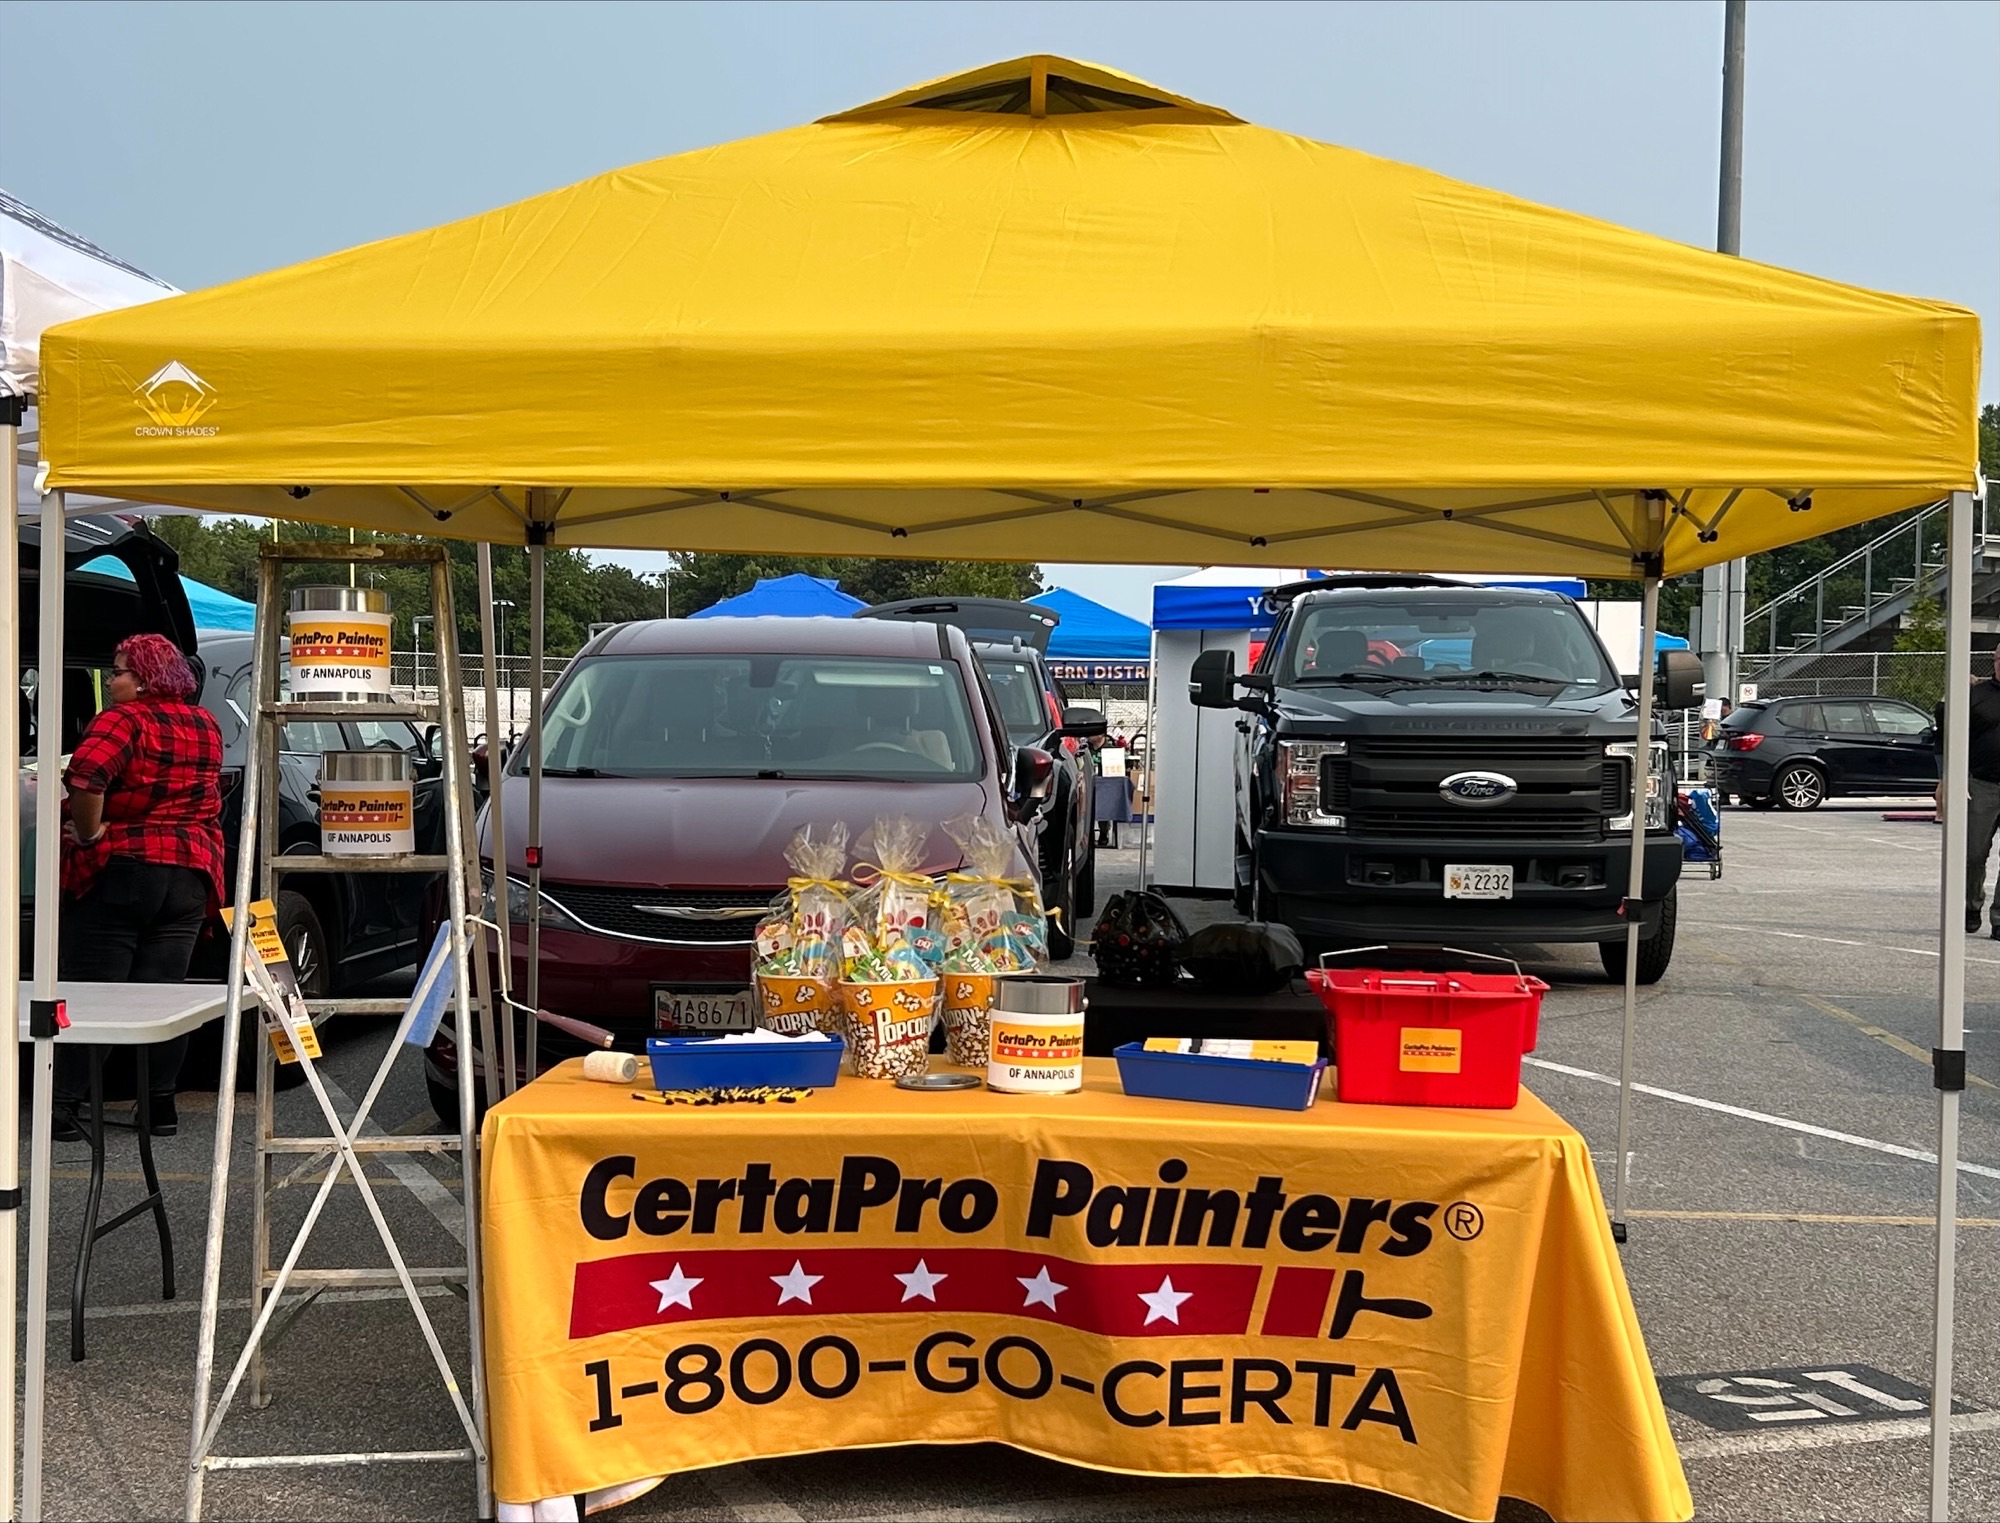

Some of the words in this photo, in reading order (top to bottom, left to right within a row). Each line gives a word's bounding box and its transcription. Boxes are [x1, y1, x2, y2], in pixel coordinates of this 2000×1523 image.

[135, 426, 173, 436] CROWN
[175, 426, 216, 436] SHADES
[337, 631, 384, 646] Painters
[300, 668, 311, 679] OF
[313, 668, 372, 680] ANNAPOLIS
[359, 800, 404, 811] Painters
[338, 833, 392, 843] ANNAPOLIS
[998, 1031, 1046, 1047] CertaPro
[1009, 1067, 1021, 1079] OF
[1023, 1069, 1075, 1080] ANNAPOLIS
[580, 1155, 998, 1241] CertaPro
[585, 1330, 1418, 1445] 1-800-GO-CERTA
